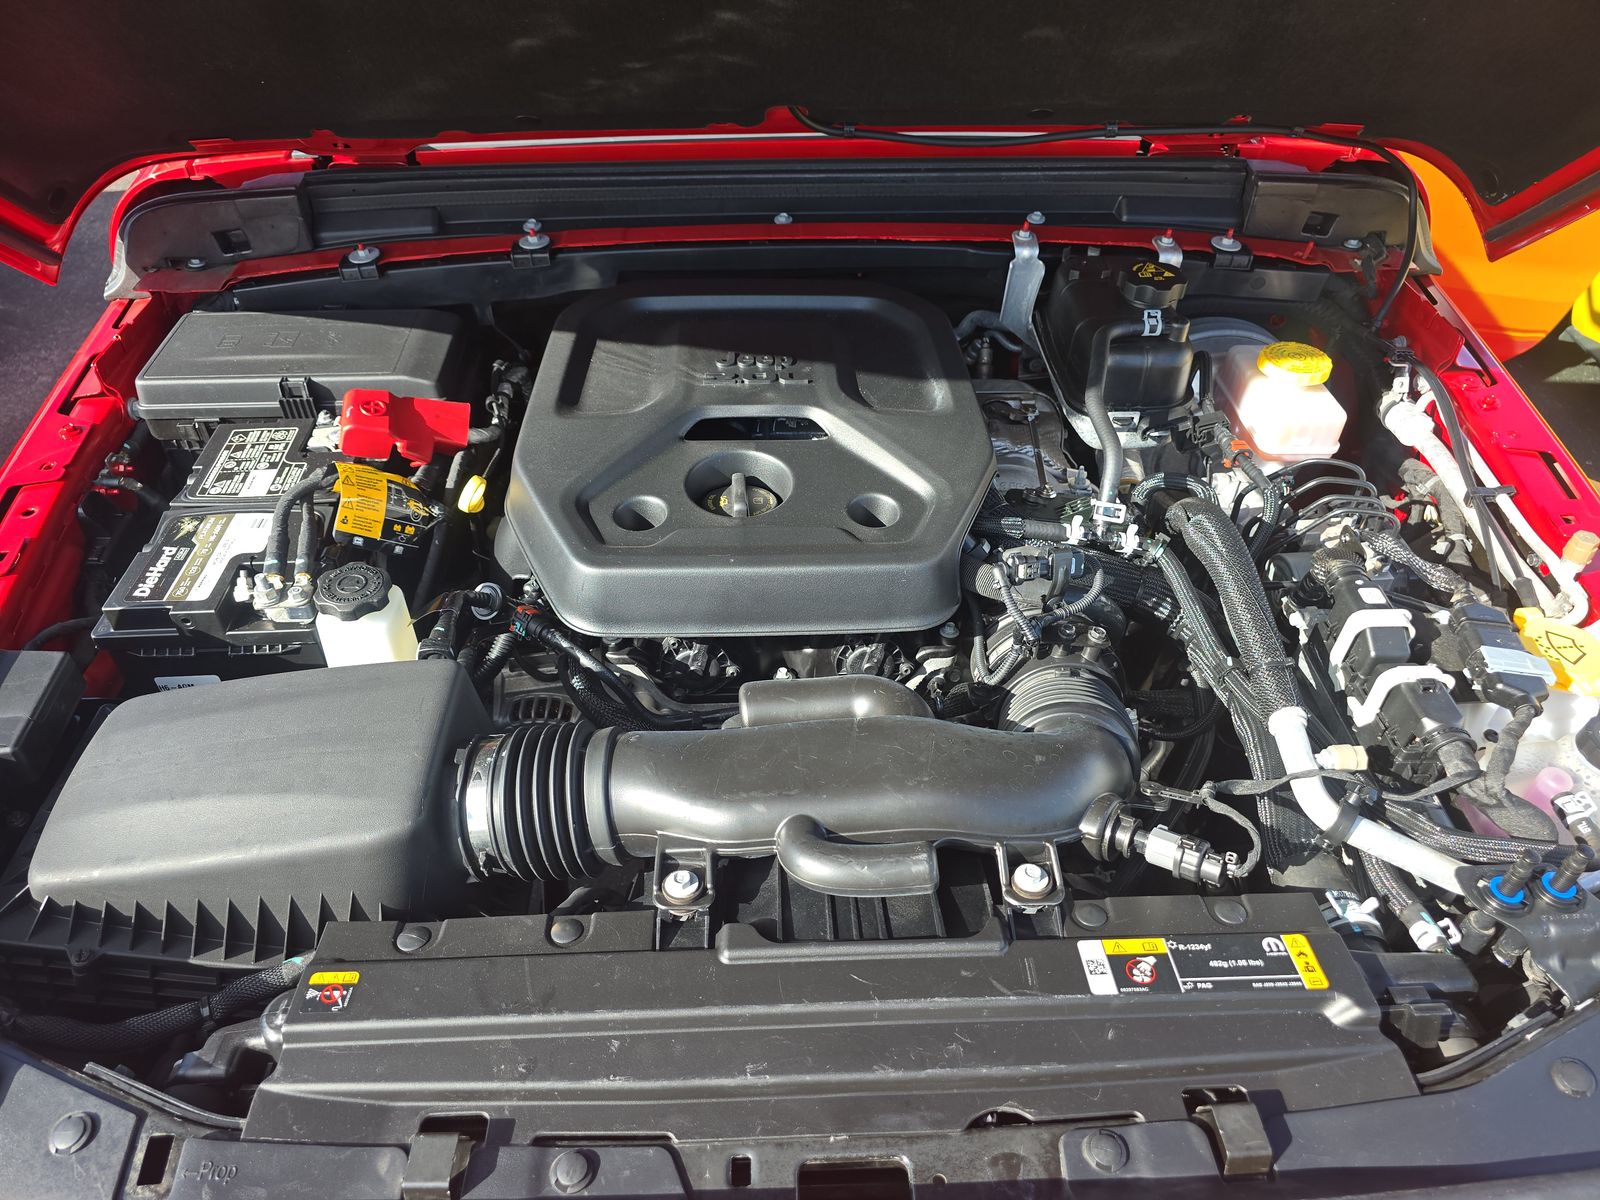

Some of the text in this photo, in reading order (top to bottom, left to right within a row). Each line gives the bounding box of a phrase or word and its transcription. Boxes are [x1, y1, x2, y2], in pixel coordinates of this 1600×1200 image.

[715, 351, 797, 370] Jeep
[132, 546, 179, 597] DieHard
[197, 1161, 238, 1186] Prop
